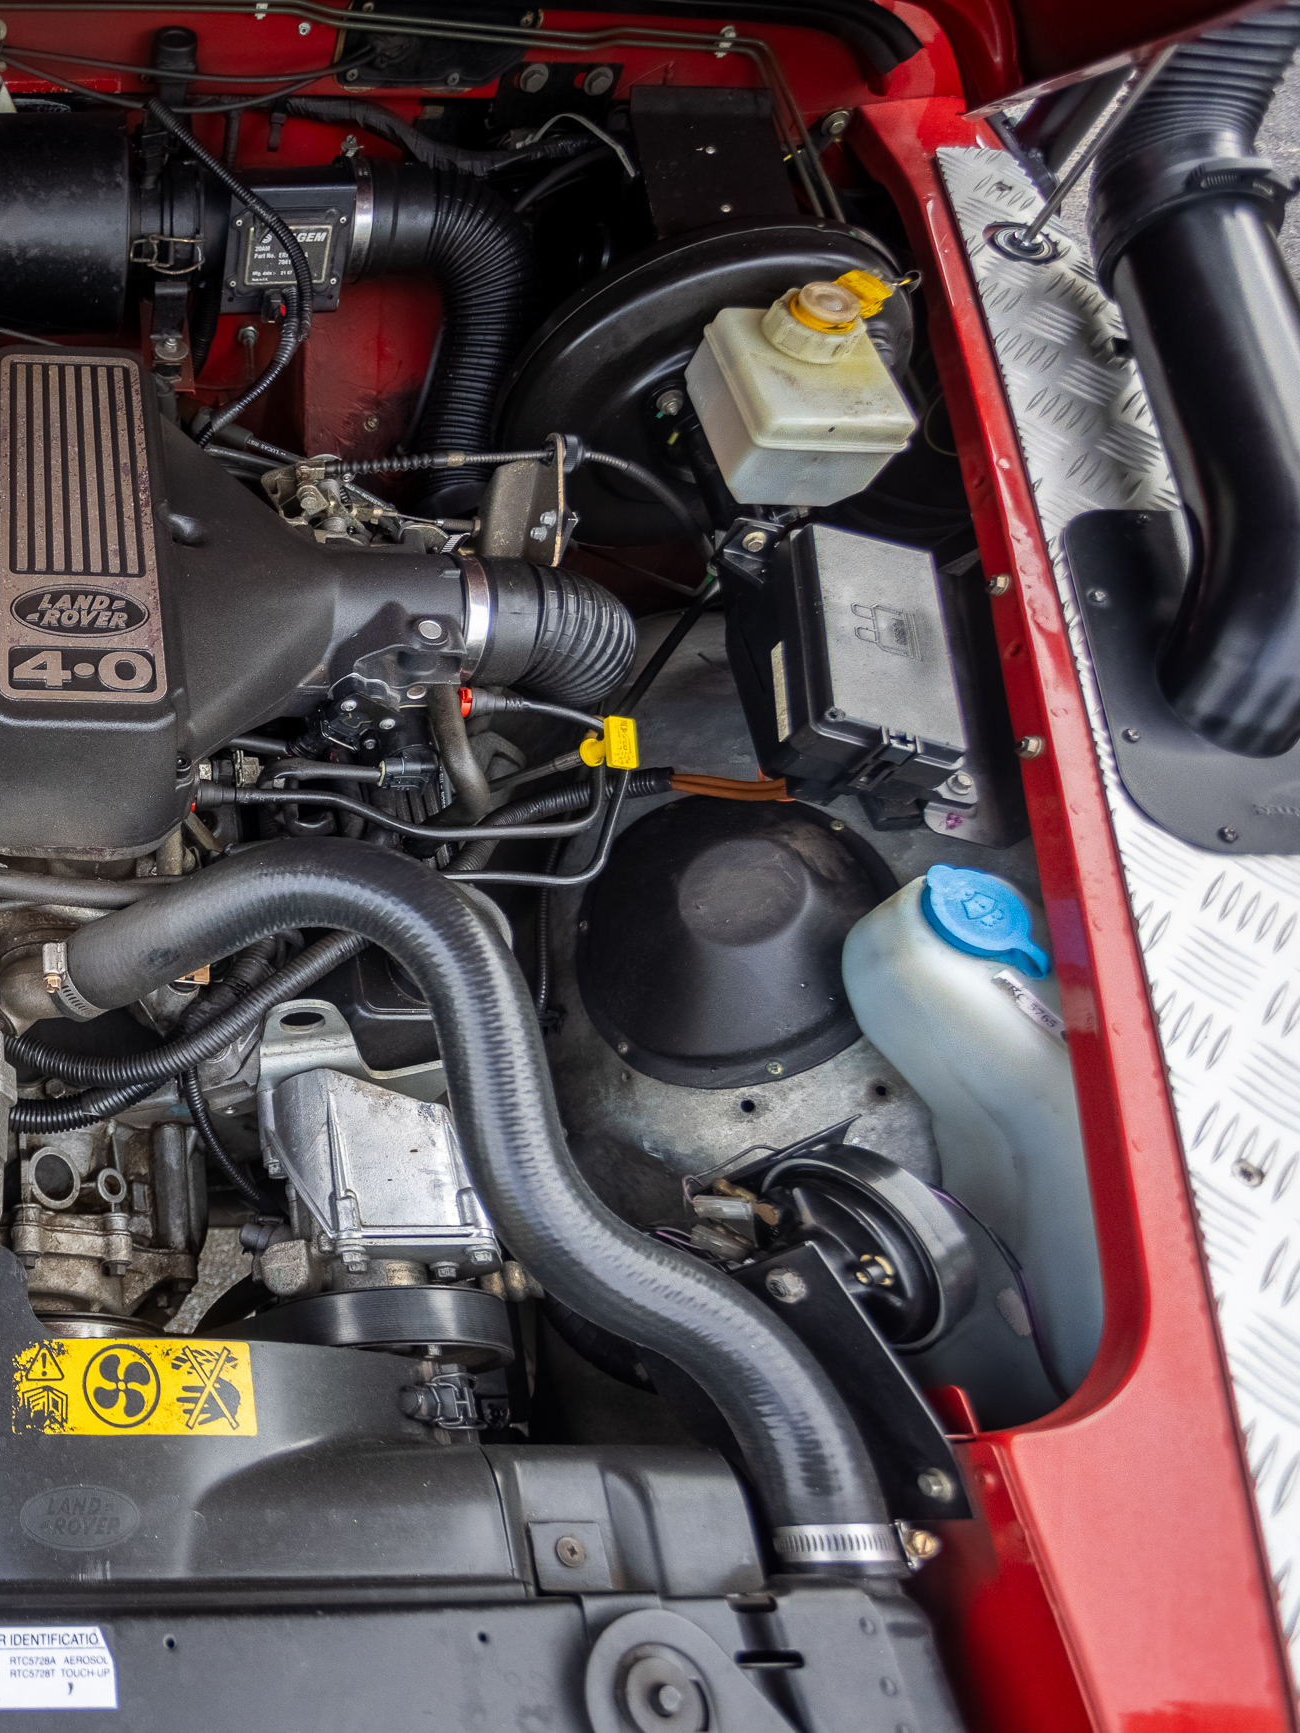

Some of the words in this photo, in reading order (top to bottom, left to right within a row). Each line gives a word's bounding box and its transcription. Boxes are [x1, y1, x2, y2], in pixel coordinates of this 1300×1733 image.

[38, 593, 110, 611] LAND
[40, 609, 129, 629] ROVER
[45, 1497, 101, 1515] LAND
[53, 1516, 120, 1535] ROVER
[10, 1656, 56, 1666] RTC5728A
[63, 1656, 109, 1666] AEROSOL
[10, 1669, 56, 1678] RTC5728T
[61, 1669, 110, 1678] TOUCH-UP
